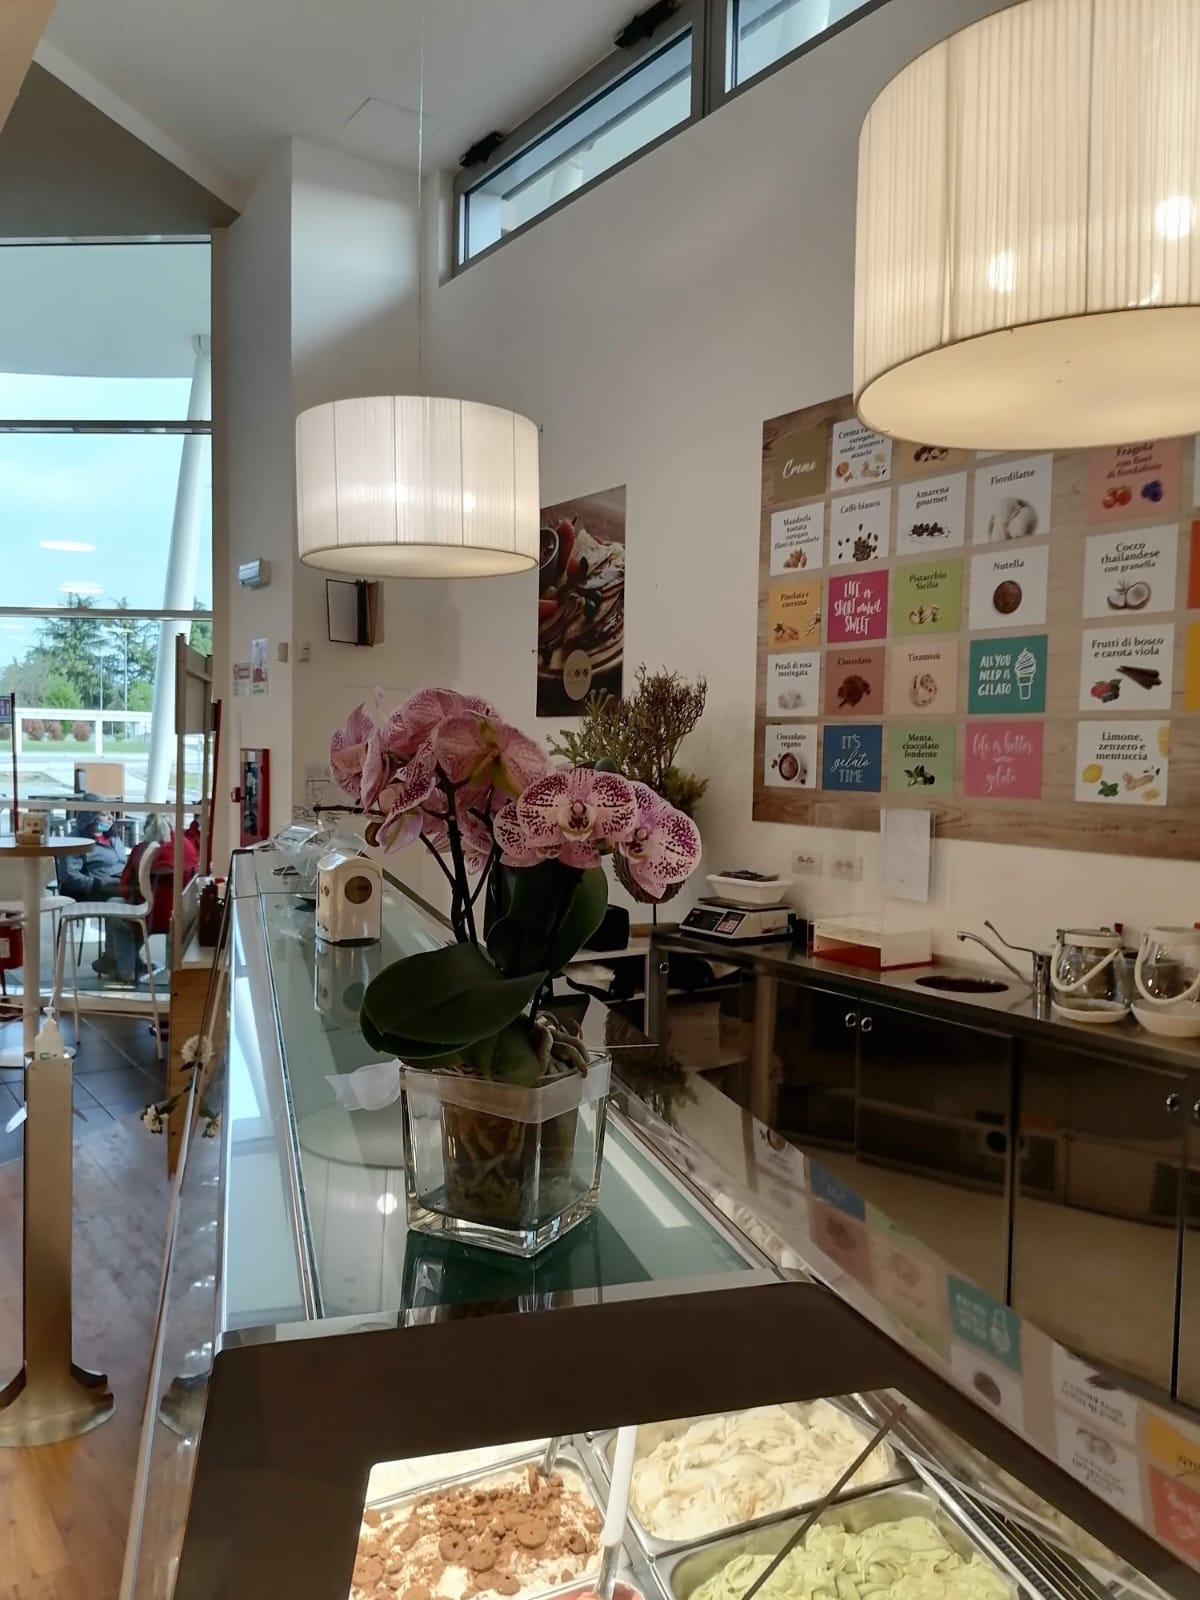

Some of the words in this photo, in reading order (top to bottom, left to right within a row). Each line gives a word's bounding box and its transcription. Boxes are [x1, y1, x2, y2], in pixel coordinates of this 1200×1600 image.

[782, 459, 818, 479] Creme
[991, 470, 1036, 485] Fiordilatte
[915, 486, 950, 499] Amarena
[858, 500, 881, 511] bianco
[916, 495, 948, 509] gourmet
[783, 514, 812, 526] Mandorla
[1115, 543, 1146, 553] Cocco
[1101, 550, 1161, 564] thailandese
[993, 559, 1025, 571] Nutella
[1120, 559, 1156, 573] granella
[908, 571, 948, 583] Pistacchio
[844, 580, 861, 599] LIFE
[916, 580, 939, 591] Sicilia
[845, 615, 871, 635] SWEET
[1091, 637, 1120, 649] Frutti
[1121, 636, 1132, 647] di
[1134, 635, 1165, 647] bosco
[1093, 651, 1101, 659] e
[1101, 648, 1133, 658] carota
[1134, 645, 1160, 657] viola
[775, 662, 791, 670] Petali
[792, 661, 799, 669] di
[837, 656, 873, 666] Cioccolato
[980, 655, 994, 668] ALL
[994, 653, 1011, 668] YOU
[778, 669, 808, 678] meringata
[979, 669, 1002, 681] NEED
[1003, 669, 1011, 680] IS
[977, 682, 1012, 696] GELATO
[776, 732, 807, 741] Cioccolato
[841, 733, 862, 749] IT'S
[908, 733, 934, 742] Menta,
[1102, 731, 1144, 742] Limone,
[780, 741, 802, 749] vegano
[902, 741, 940, 750] cioccolato
[1098, 743, 1138, 751] zenzero
[904, 749, 938, 758] fondente
[1095, 752, 1148, 761] mentuccia
[830, 748, 871, 772] gelato
[840, 769, 863, 783] TIME
